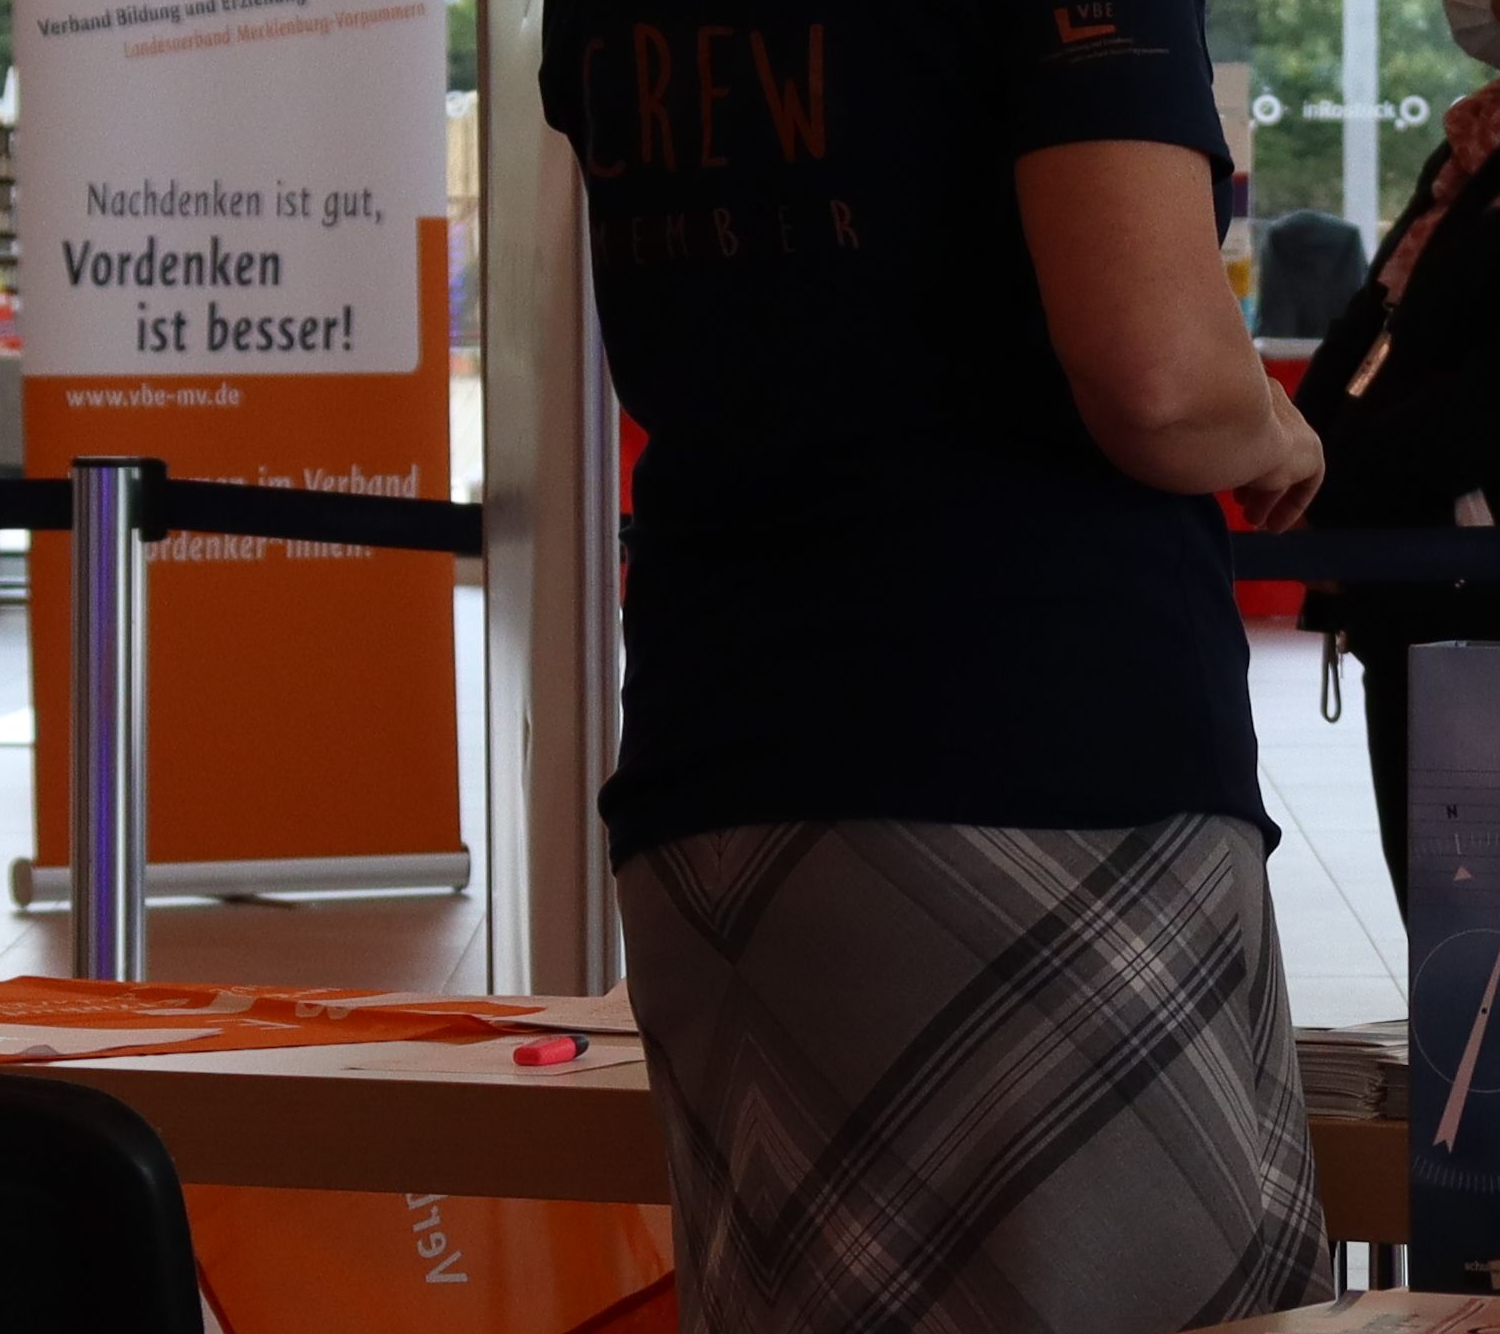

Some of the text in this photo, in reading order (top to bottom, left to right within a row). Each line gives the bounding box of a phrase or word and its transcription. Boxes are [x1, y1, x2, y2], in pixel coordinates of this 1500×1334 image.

[37, 7, 113, 38] Verband
[1076, 1, 1117, 20] VBE
[581, 21, 828, 179] CREW
[86, 179, 385, 228] Nachdenken ist gut,
[62, 234, 282, 288] Vordenken
[135, 302, 354, 354] ist besser!
[65, 383, 243, 408] www.vbe-mv.de
